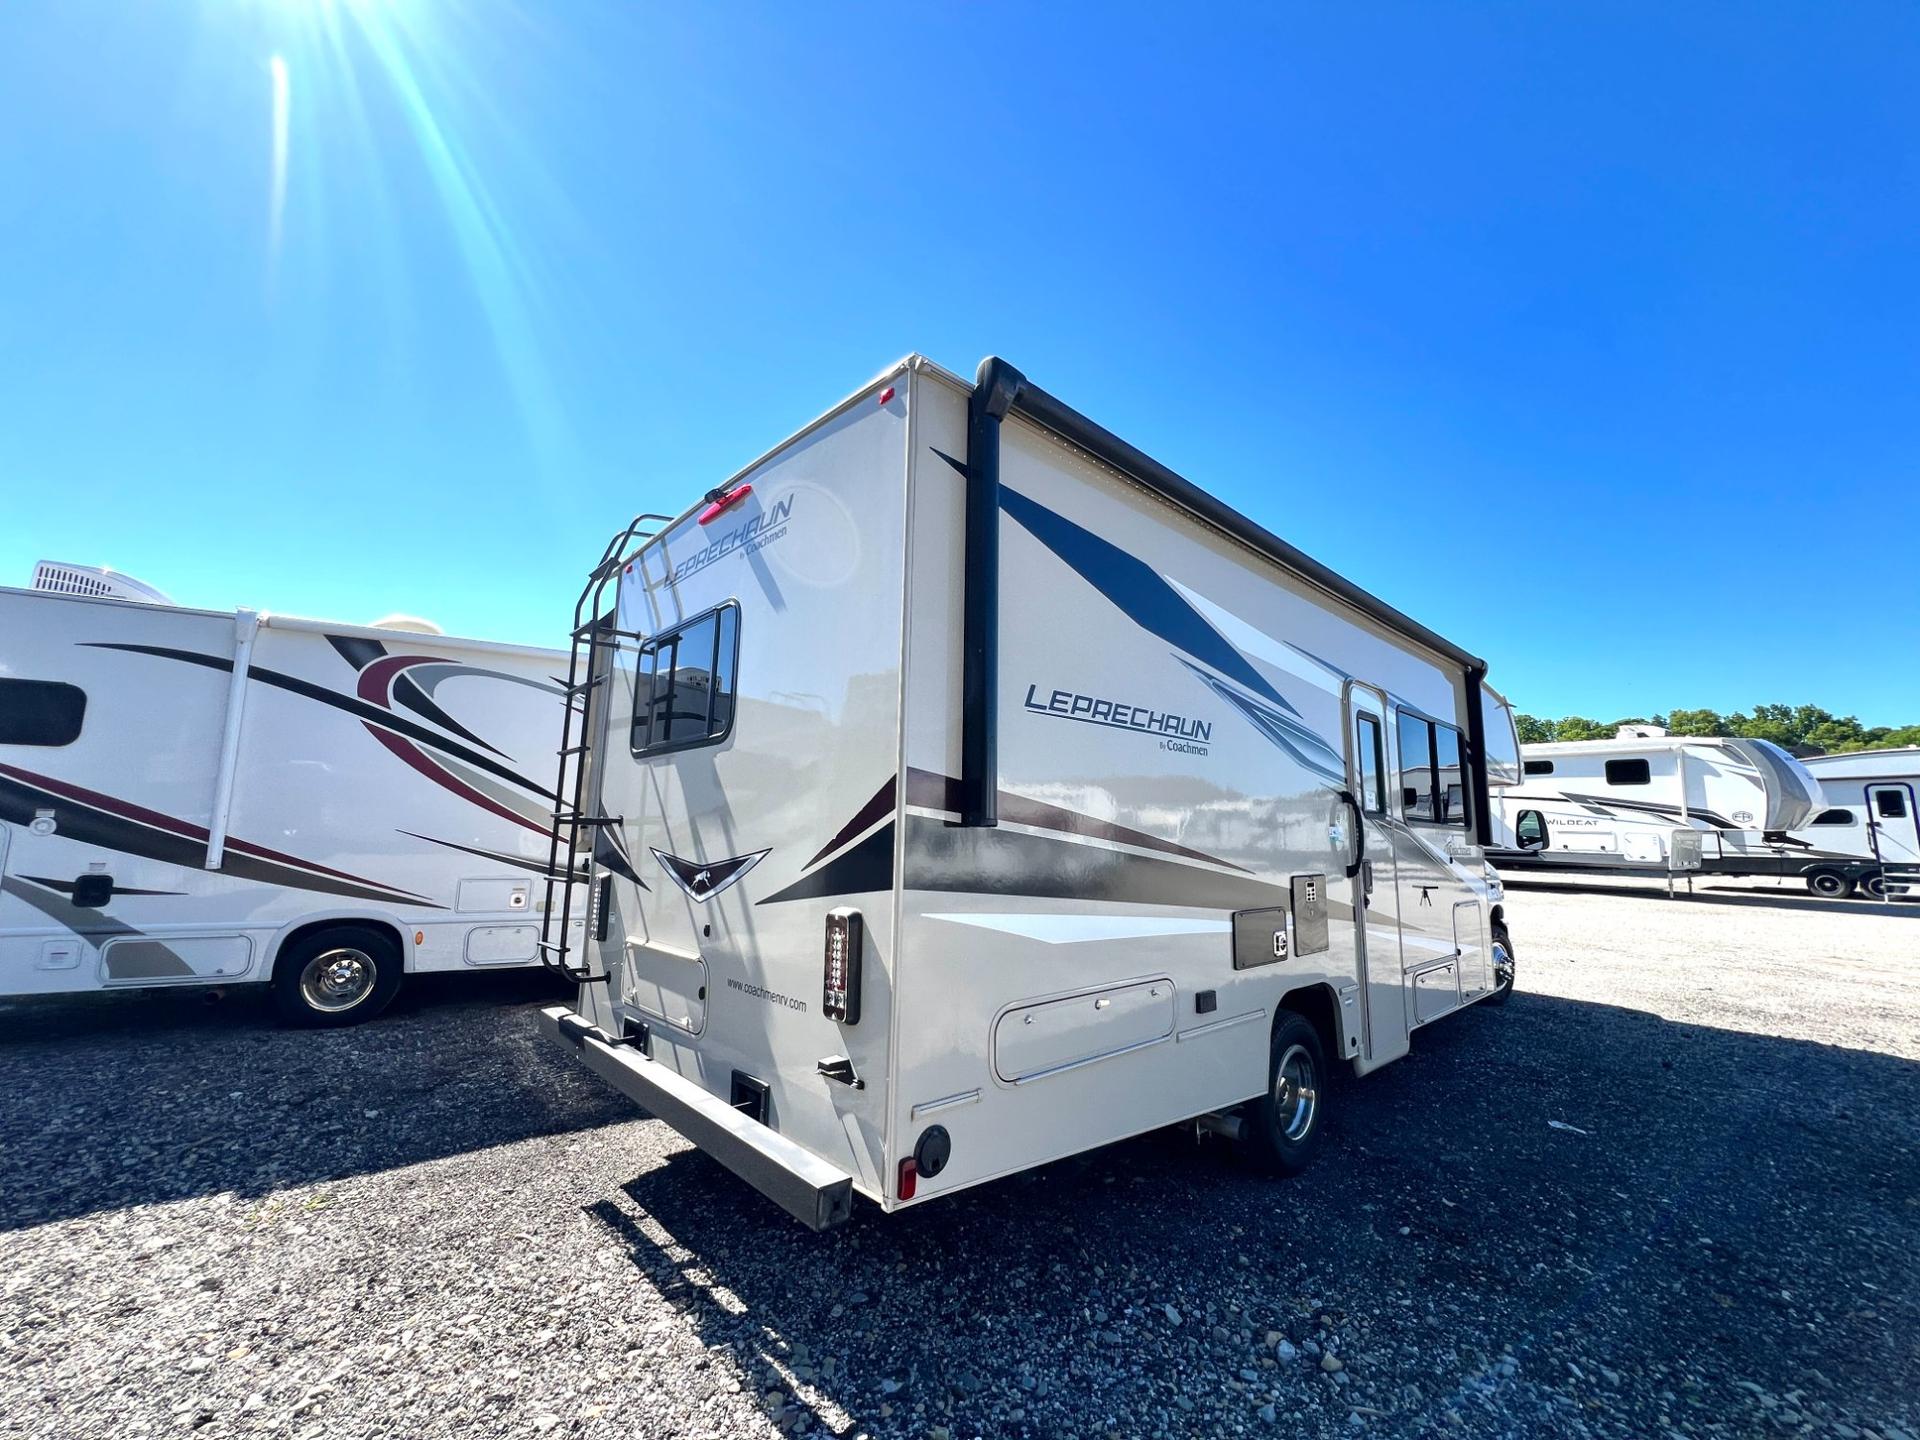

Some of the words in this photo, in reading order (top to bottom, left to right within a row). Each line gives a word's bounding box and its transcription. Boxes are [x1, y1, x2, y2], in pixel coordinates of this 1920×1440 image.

[664, 494, 794, 589] LEPRECHAUN
[1024, 684, 1212, 740] LEPRECHAUN
[1167, 739, 1208, 756] Coachmen
[727, 977, 807, 1013] www.coachmenrv.com
